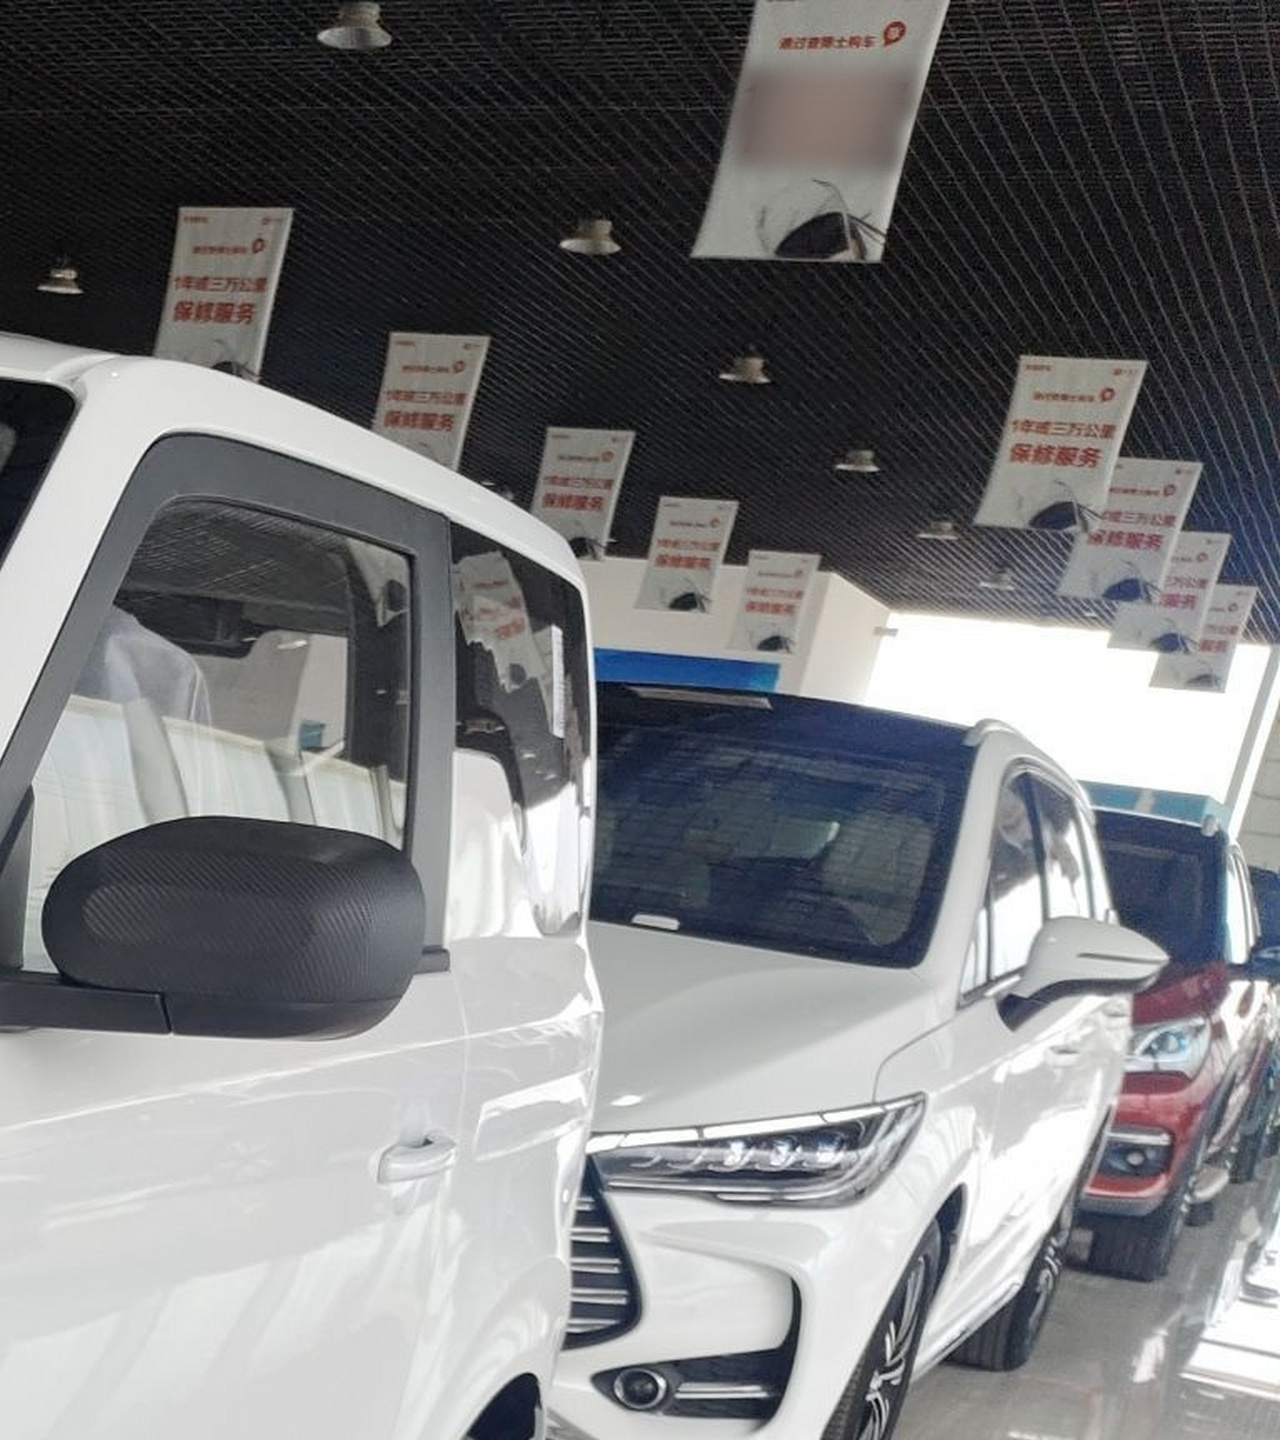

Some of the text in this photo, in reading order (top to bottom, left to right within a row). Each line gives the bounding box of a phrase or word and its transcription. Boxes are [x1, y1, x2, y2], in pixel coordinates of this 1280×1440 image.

[172, 300, 256, 325] 保修服务
[1012, 418, 1117, 440] 1年或三万公里
[1010, 442, 1102, 469] 保修服务
